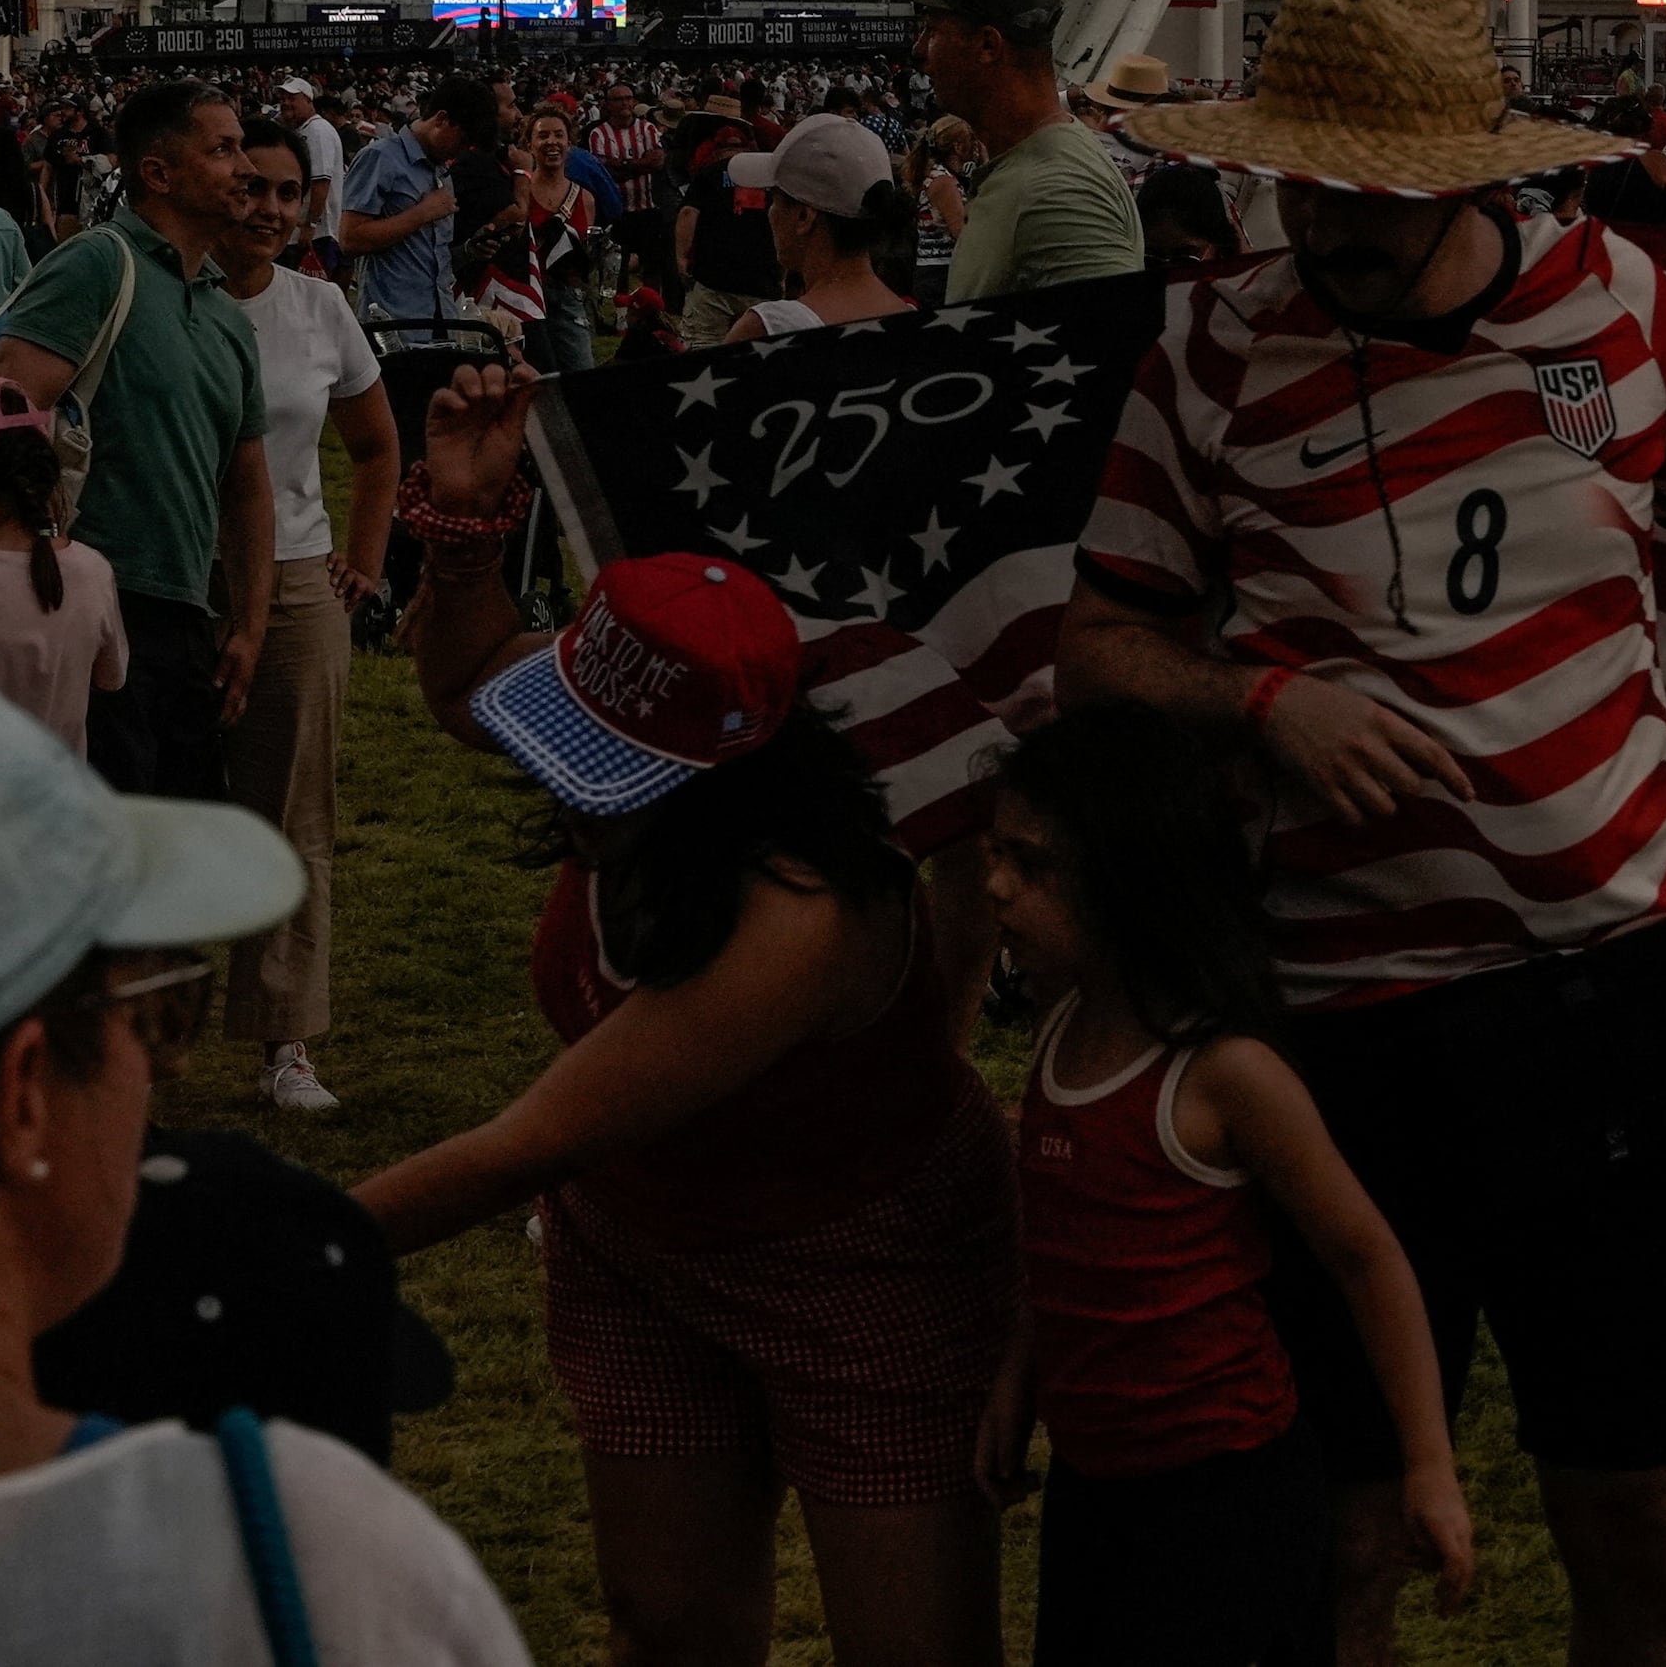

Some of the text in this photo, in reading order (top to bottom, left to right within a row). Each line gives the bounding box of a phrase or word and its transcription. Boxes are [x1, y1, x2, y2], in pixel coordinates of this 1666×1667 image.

[252, 27, 288, 38] SUNDAY
[300, 25, 357, 37] WEDNESDAY
[708, 21, 794, 44] RODEO 250
[802, 22, 837, 32] SUNDAY
[850, 22, 905, 32] WEDNESDAY
[802, 33, 849, 43] THURSDAY
[860, 33, 905, 42] SATURDAY
[157, 28, 244, 53] RODEO 250
[253, 38, 299, 49] THURSDAY
[311, 37, 357, 48] SATURDAY
[1541, 365, 1600, 402] USA
[748, 370, 995, 498] 250
[1446, 487, 1507, 616] 8
[608, 626, 646, 673] TO
[635, 652, 690, 700] ME
[570, 637, 637, 717] GOOSE
